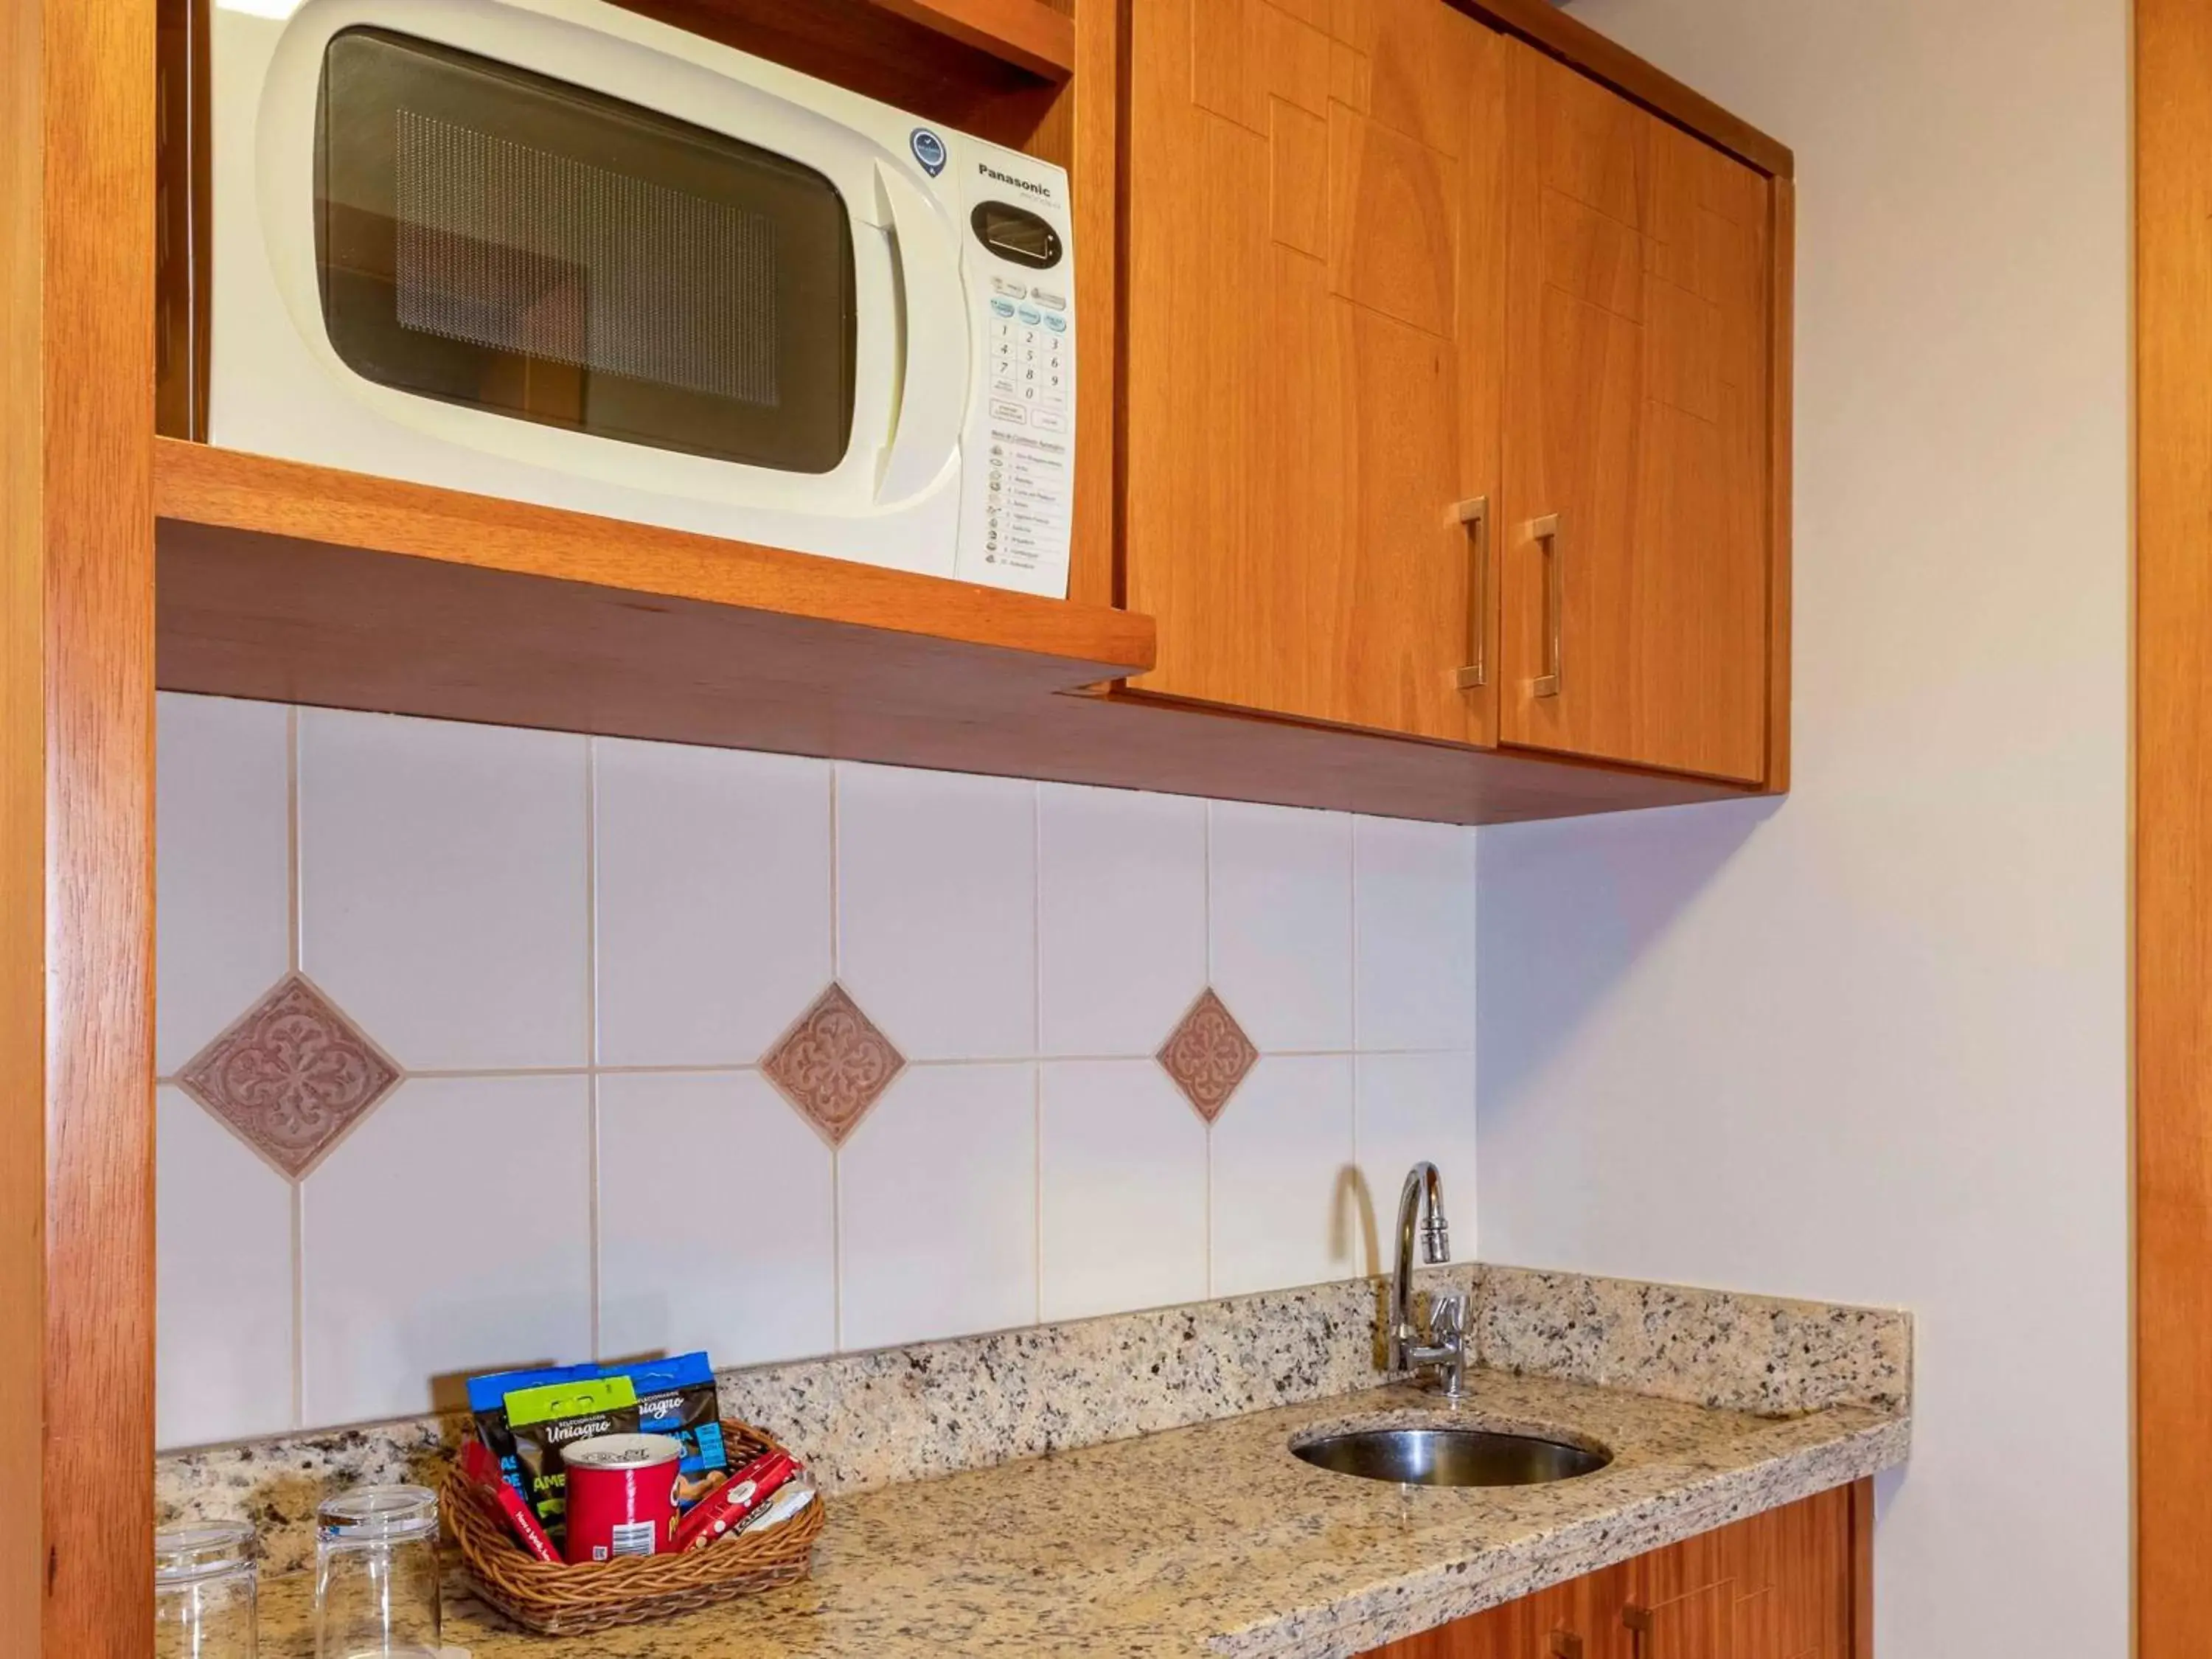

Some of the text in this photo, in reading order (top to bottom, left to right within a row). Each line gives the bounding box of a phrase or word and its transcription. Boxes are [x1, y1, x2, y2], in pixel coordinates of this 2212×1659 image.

[978, 163, 1051, 198] Panasonic
[1003, 324, 1059, 350] 1 2 3
[1001, 344, 1058, 369] 4 5 6
[1000, 362, 1058, 386] 7 8 9
[1025, 387, 1034, 399] 0
[545, 1420, 612, 1444] Uniagro
